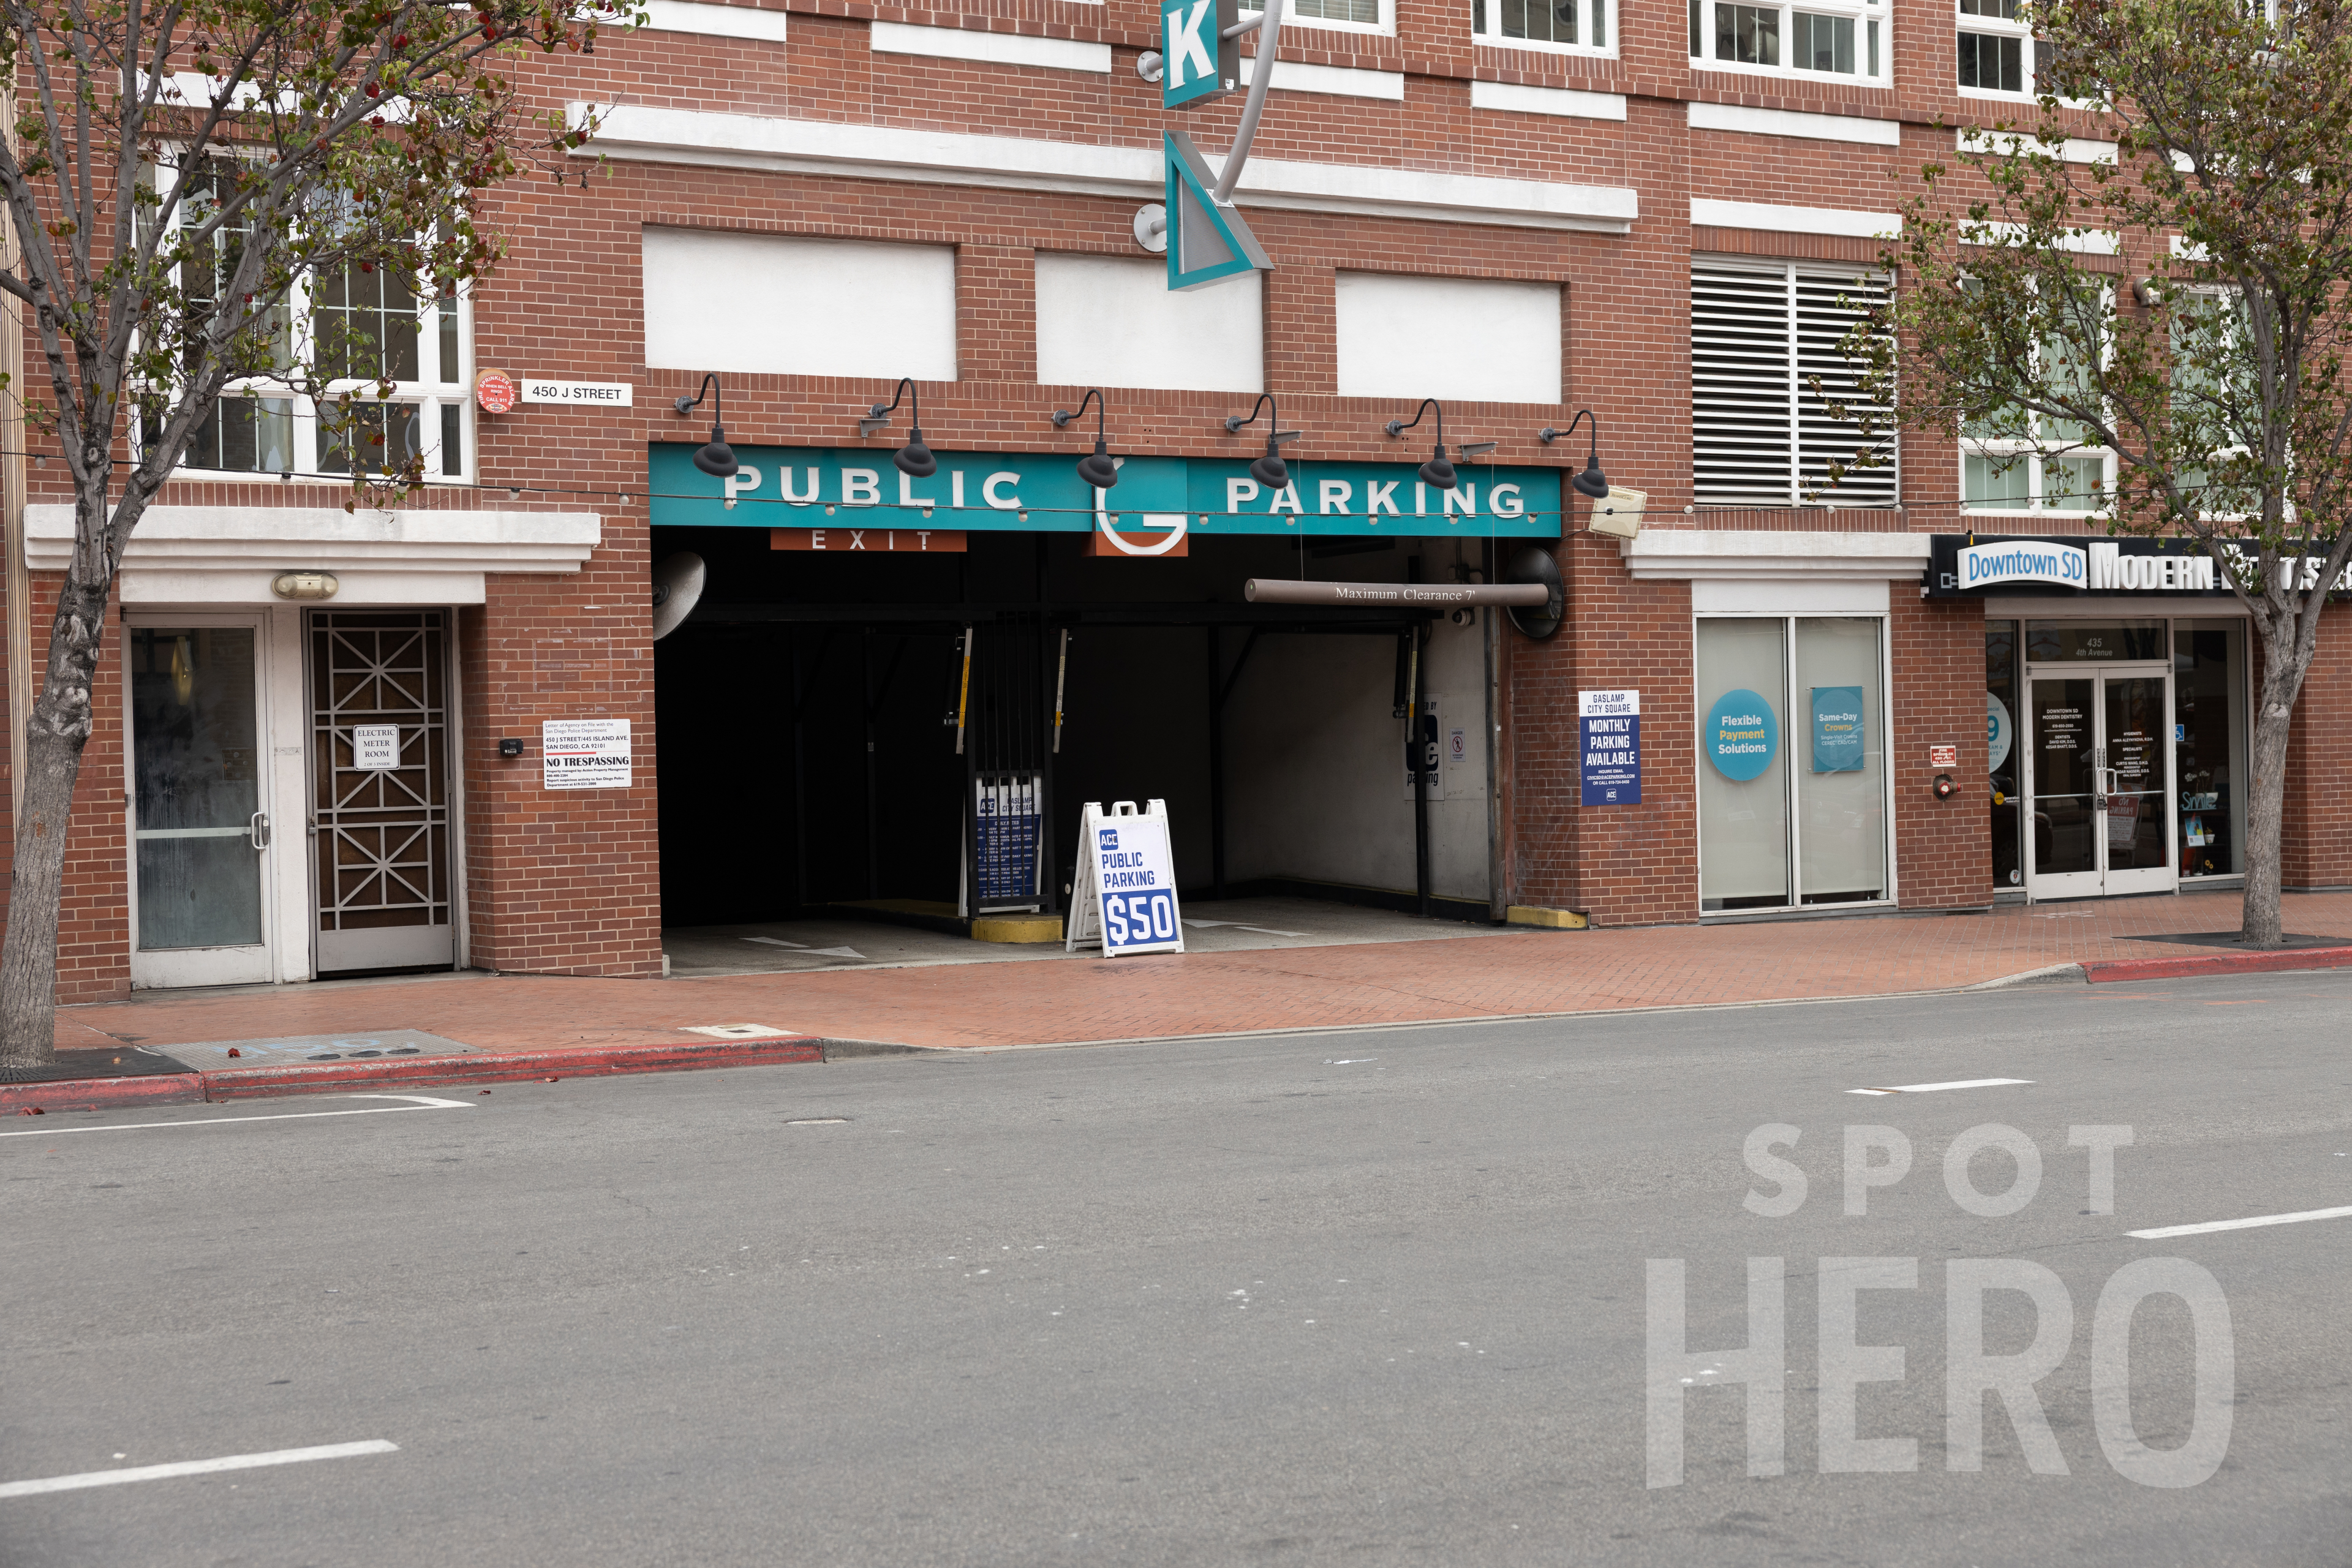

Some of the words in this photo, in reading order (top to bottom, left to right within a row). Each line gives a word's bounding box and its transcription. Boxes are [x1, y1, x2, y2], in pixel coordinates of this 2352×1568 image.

[1166, 0, 1216, 90] K
[480, 375, 510, 388] SPRINKLER
[532, 386, 557, 397] 450
[562, 387, 568, 397] J
[573, 388, 621, 399] STREET
[724, 465, 1023, 509] PUBLIC
[1225, 478, 1525, 519] PARKING
[812, 530, 931, 551] EXIT
[1969, 550, 2057, 581] Downtown
[2062, 551, 2082, 580] SD
[2089, 542, 2213, 590] MODERN
[1336, 588, 1397, 599] Maximum
[1404, 589, 1461, 600] Clearance
[2087, 638, 2102, 647] 435
[1593, 693, 1624, 703] GASLAMP
[1588, 704, 1602, 713] CITY
[1605, 704, 1630, 713] SQUARE
[1722, 715, 1762, 726] Flexible
[1819, 713, 1857, 722] Same-Day
[1589, 718, 1630, 733] MONTHLY
[1590, 735, 1630, 749] PARKING
[1720, 729, 1765, 742] Payment
[1719, 743, 1766, 754] Solutions
[546, 758, 560, 767] NO
[564, 756, 629, 766] TRESPASSING
[1586, 751, 1635, 766] AVAILABLE
[1408, 771, 1439, 786] paing
[1101, 834, 1117, 846] ACE
[1102, 852, 1143, 869] PUBLIC
[1104, 870, 1155, 888] PARKING
[1106, 894, 1174, 945] $50
